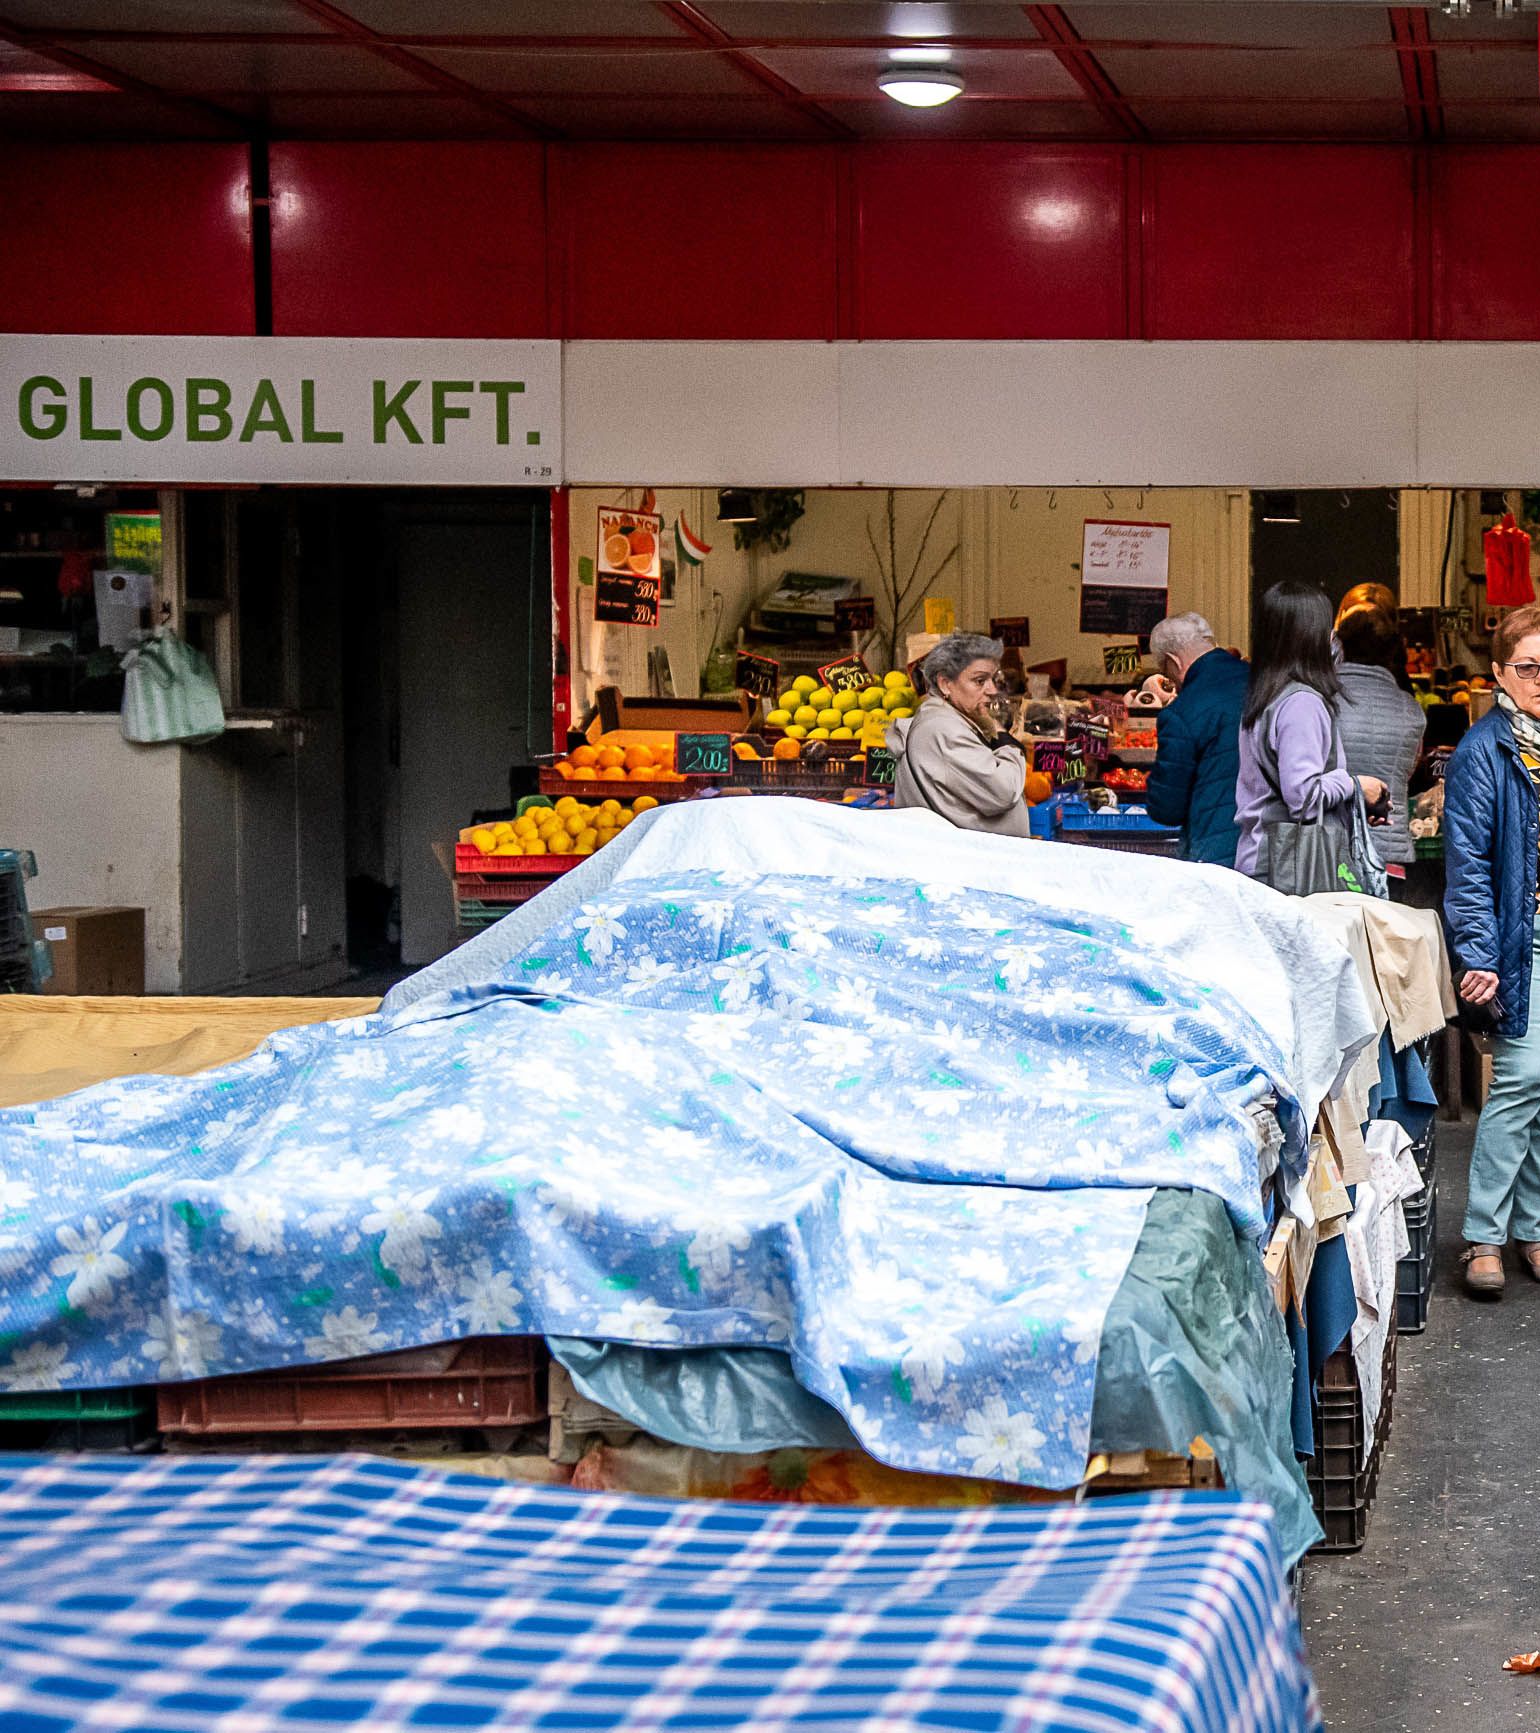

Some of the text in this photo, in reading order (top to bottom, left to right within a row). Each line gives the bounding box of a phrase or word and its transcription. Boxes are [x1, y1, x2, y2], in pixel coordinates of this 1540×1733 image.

[18, 374, 541, 446] GLOBAL KFT.
[685, 746, 722, 771] 200
[871, 760, 896, 785] 48
